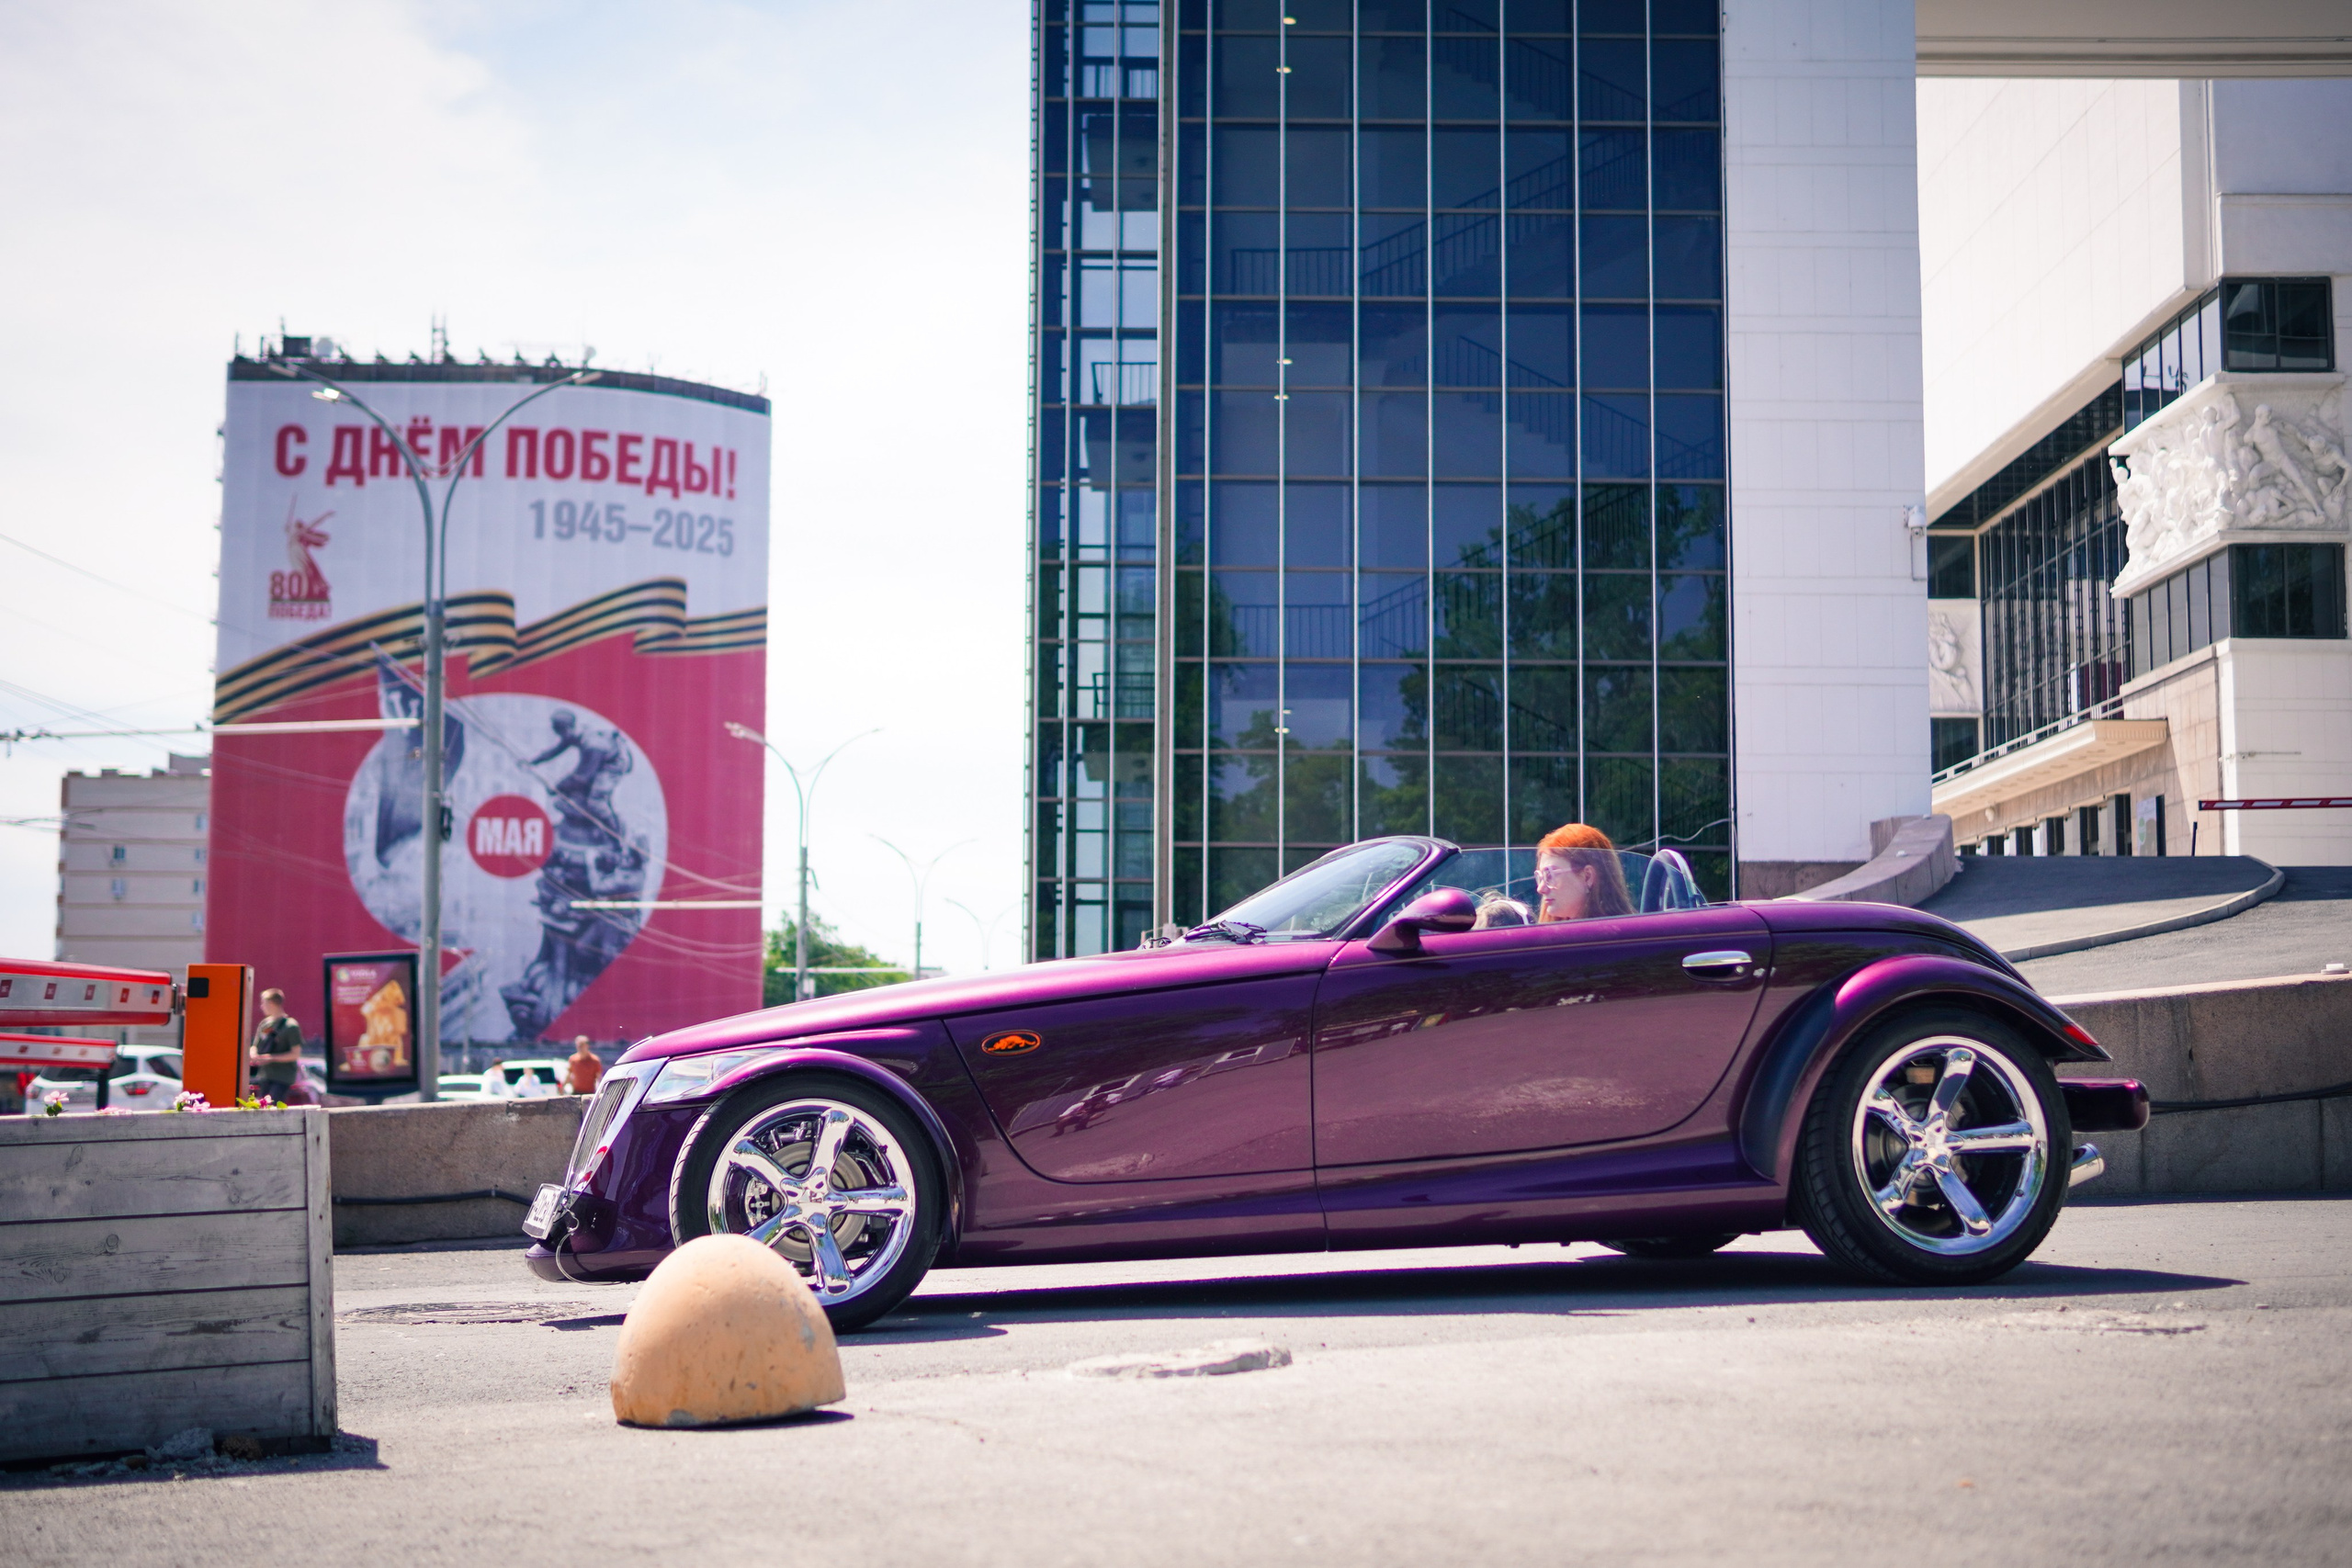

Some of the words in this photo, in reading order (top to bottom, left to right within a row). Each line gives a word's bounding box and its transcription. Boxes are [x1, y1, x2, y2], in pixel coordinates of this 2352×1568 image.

[276, 423, 307, 478] С
[325, 416, 486, 487] ДНЁМ
[505, 427, 737, 500] ПОБЕДЫ!
[476, 817, 544, 856] МАЯ
